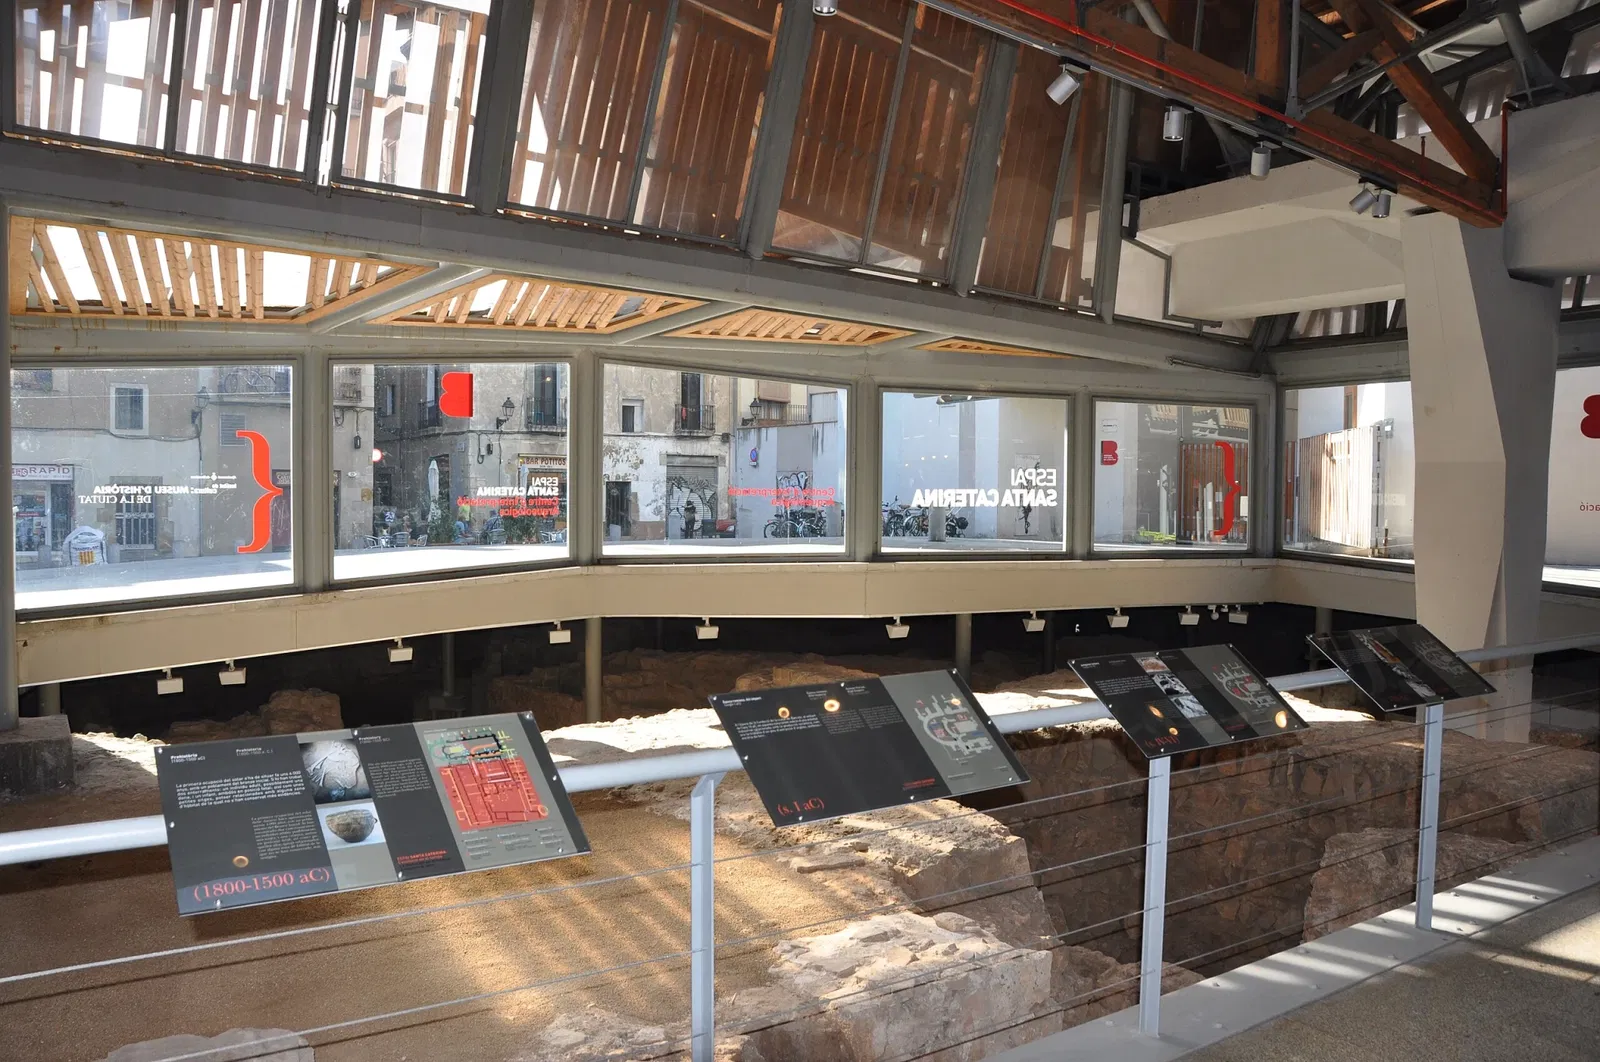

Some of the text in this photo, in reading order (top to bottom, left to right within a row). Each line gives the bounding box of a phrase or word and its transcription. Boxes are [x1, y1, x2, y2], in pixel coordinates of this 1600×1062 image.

[540, 457, 566, 466] POTITOS
[804, 796, 826, 811] aC)
[194, 867, 331, 902] (1800-1500 aC)
